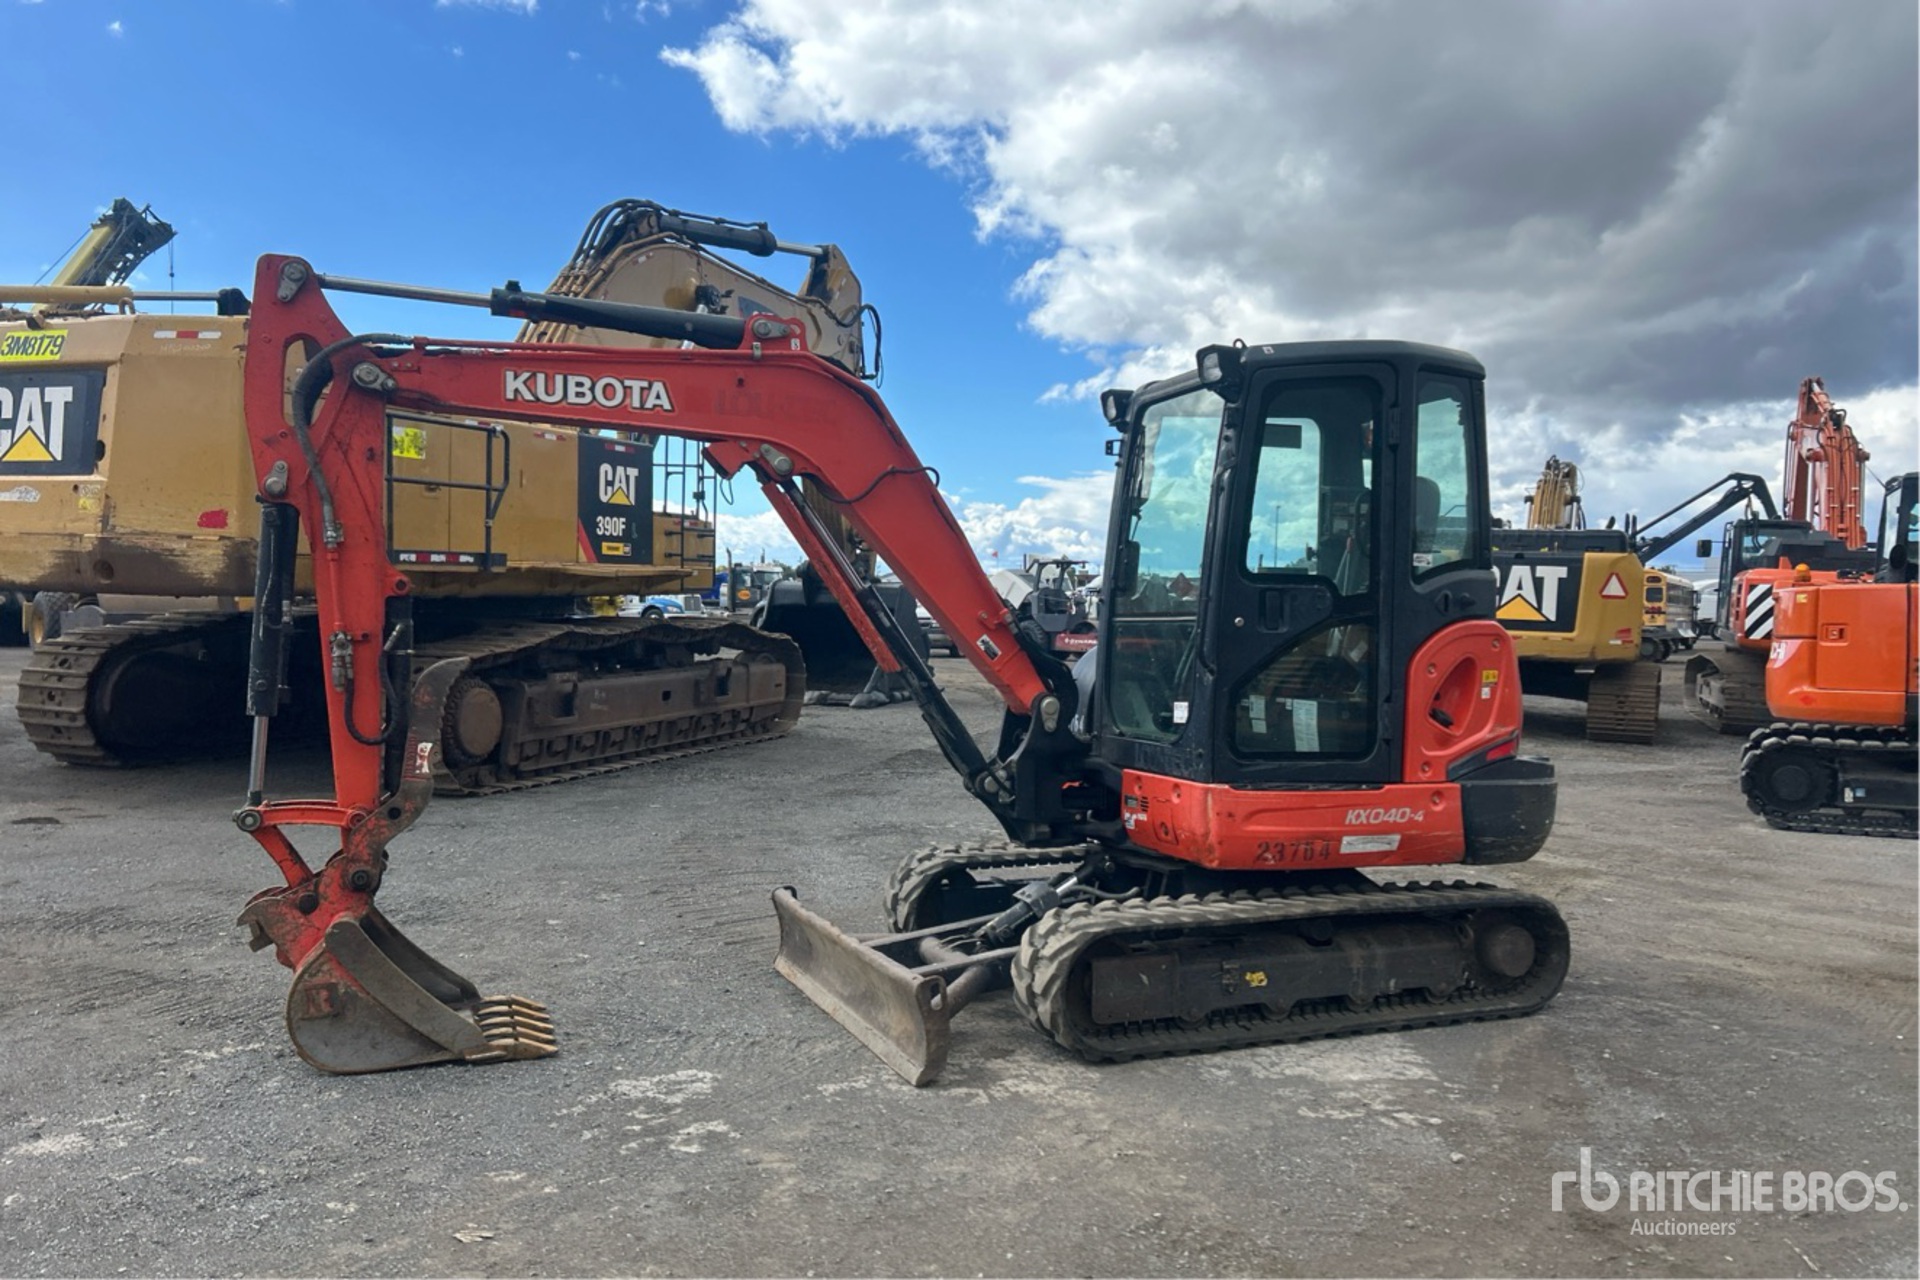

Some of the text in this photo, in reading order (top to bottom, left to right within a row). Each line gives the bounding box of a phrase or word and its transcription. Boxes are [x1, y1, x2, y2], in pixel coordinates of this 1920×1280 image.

[1, 334, 66, 356] 3M8179
[504, 370, 672, 411] KUBOTA
[599, 462, 639, 506] CAT
[595, 516, 627, 536] 390F
[1492, 565, 1568, 622] AT
